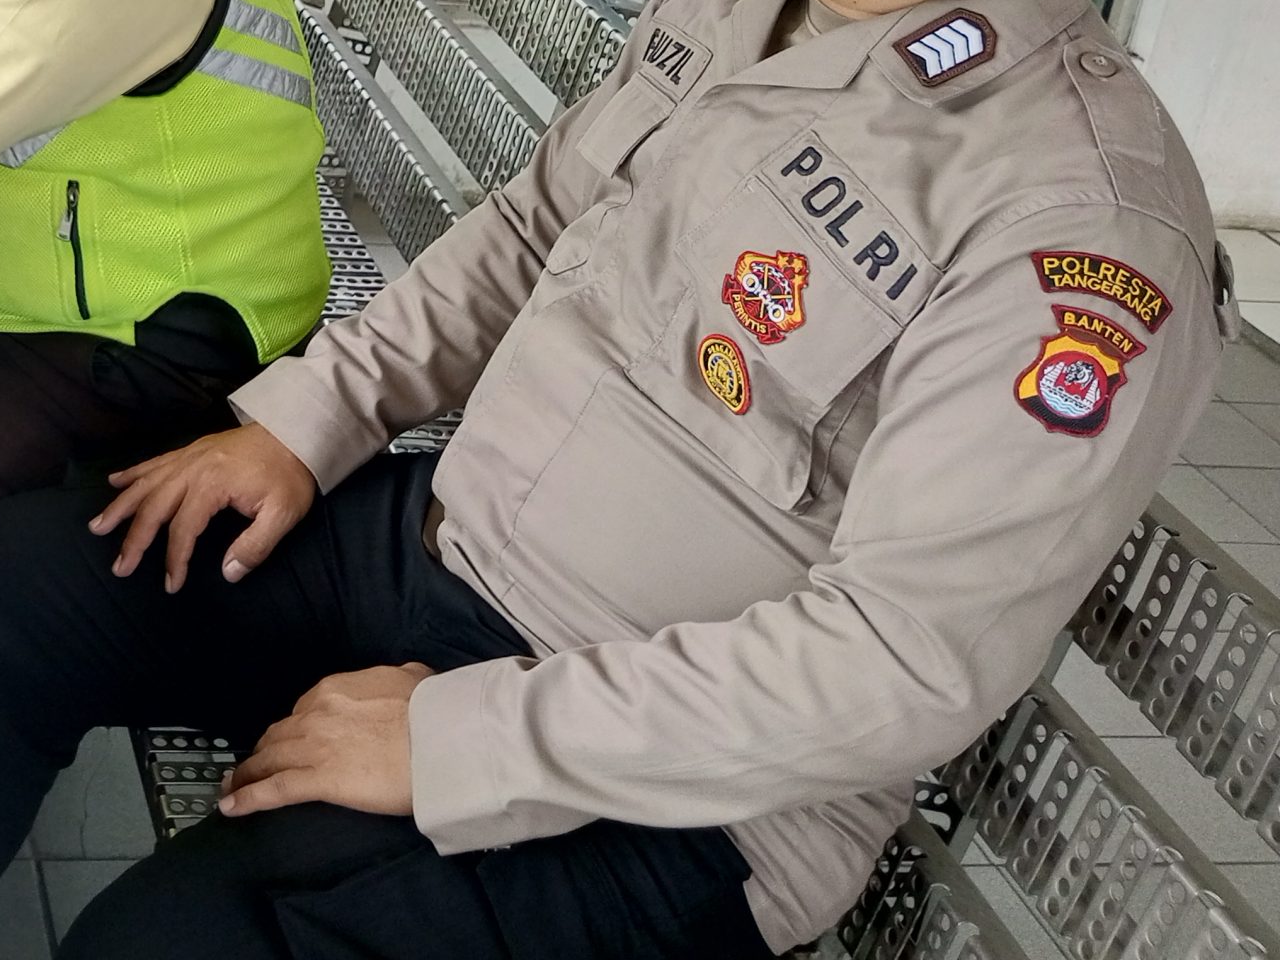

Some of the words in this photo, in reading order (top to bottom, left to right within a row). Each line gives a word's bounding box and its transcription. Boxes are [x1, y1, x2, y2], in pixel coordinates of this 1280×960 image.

[780, 146, 918, 301] POLRI
[1043, 257, 1162, 316] POLRESTA
[1049, 275, 1153, 324] TANGERANG
[732, 294, 767, 333] PERINTIS
[1063, 312, 1133, 353] BANTEN
